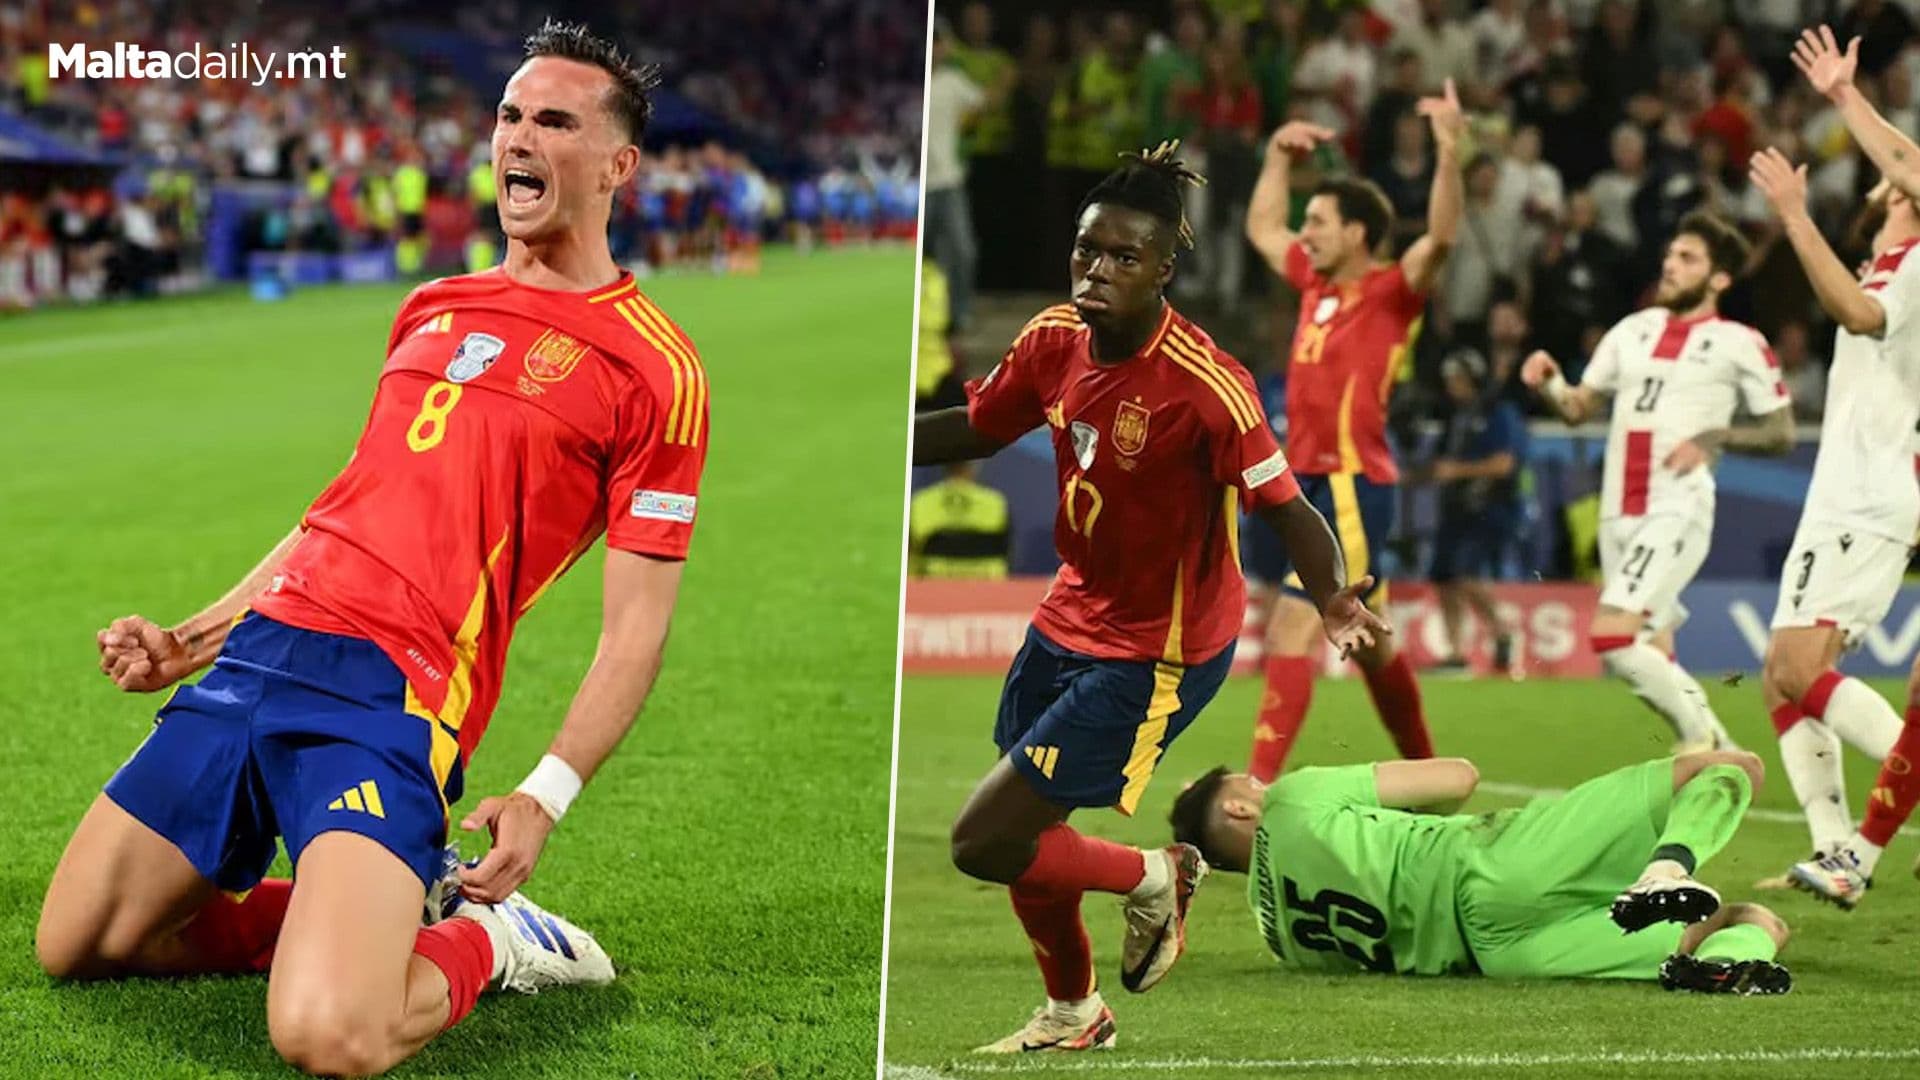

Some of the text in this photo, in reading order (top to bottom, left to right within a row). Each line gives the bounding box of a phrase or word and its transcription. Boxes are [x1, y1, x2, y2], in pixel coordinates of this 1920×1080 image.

[1295, 322, 1332, 364] 21
[406, 380, 463, 453] 8
[1066, 474, 1103, 539] 17
[1621, 545, 1655, 580] 21
[1796, 551, 1815, 591] 3
[1283, 875, 1396, 973] 25
